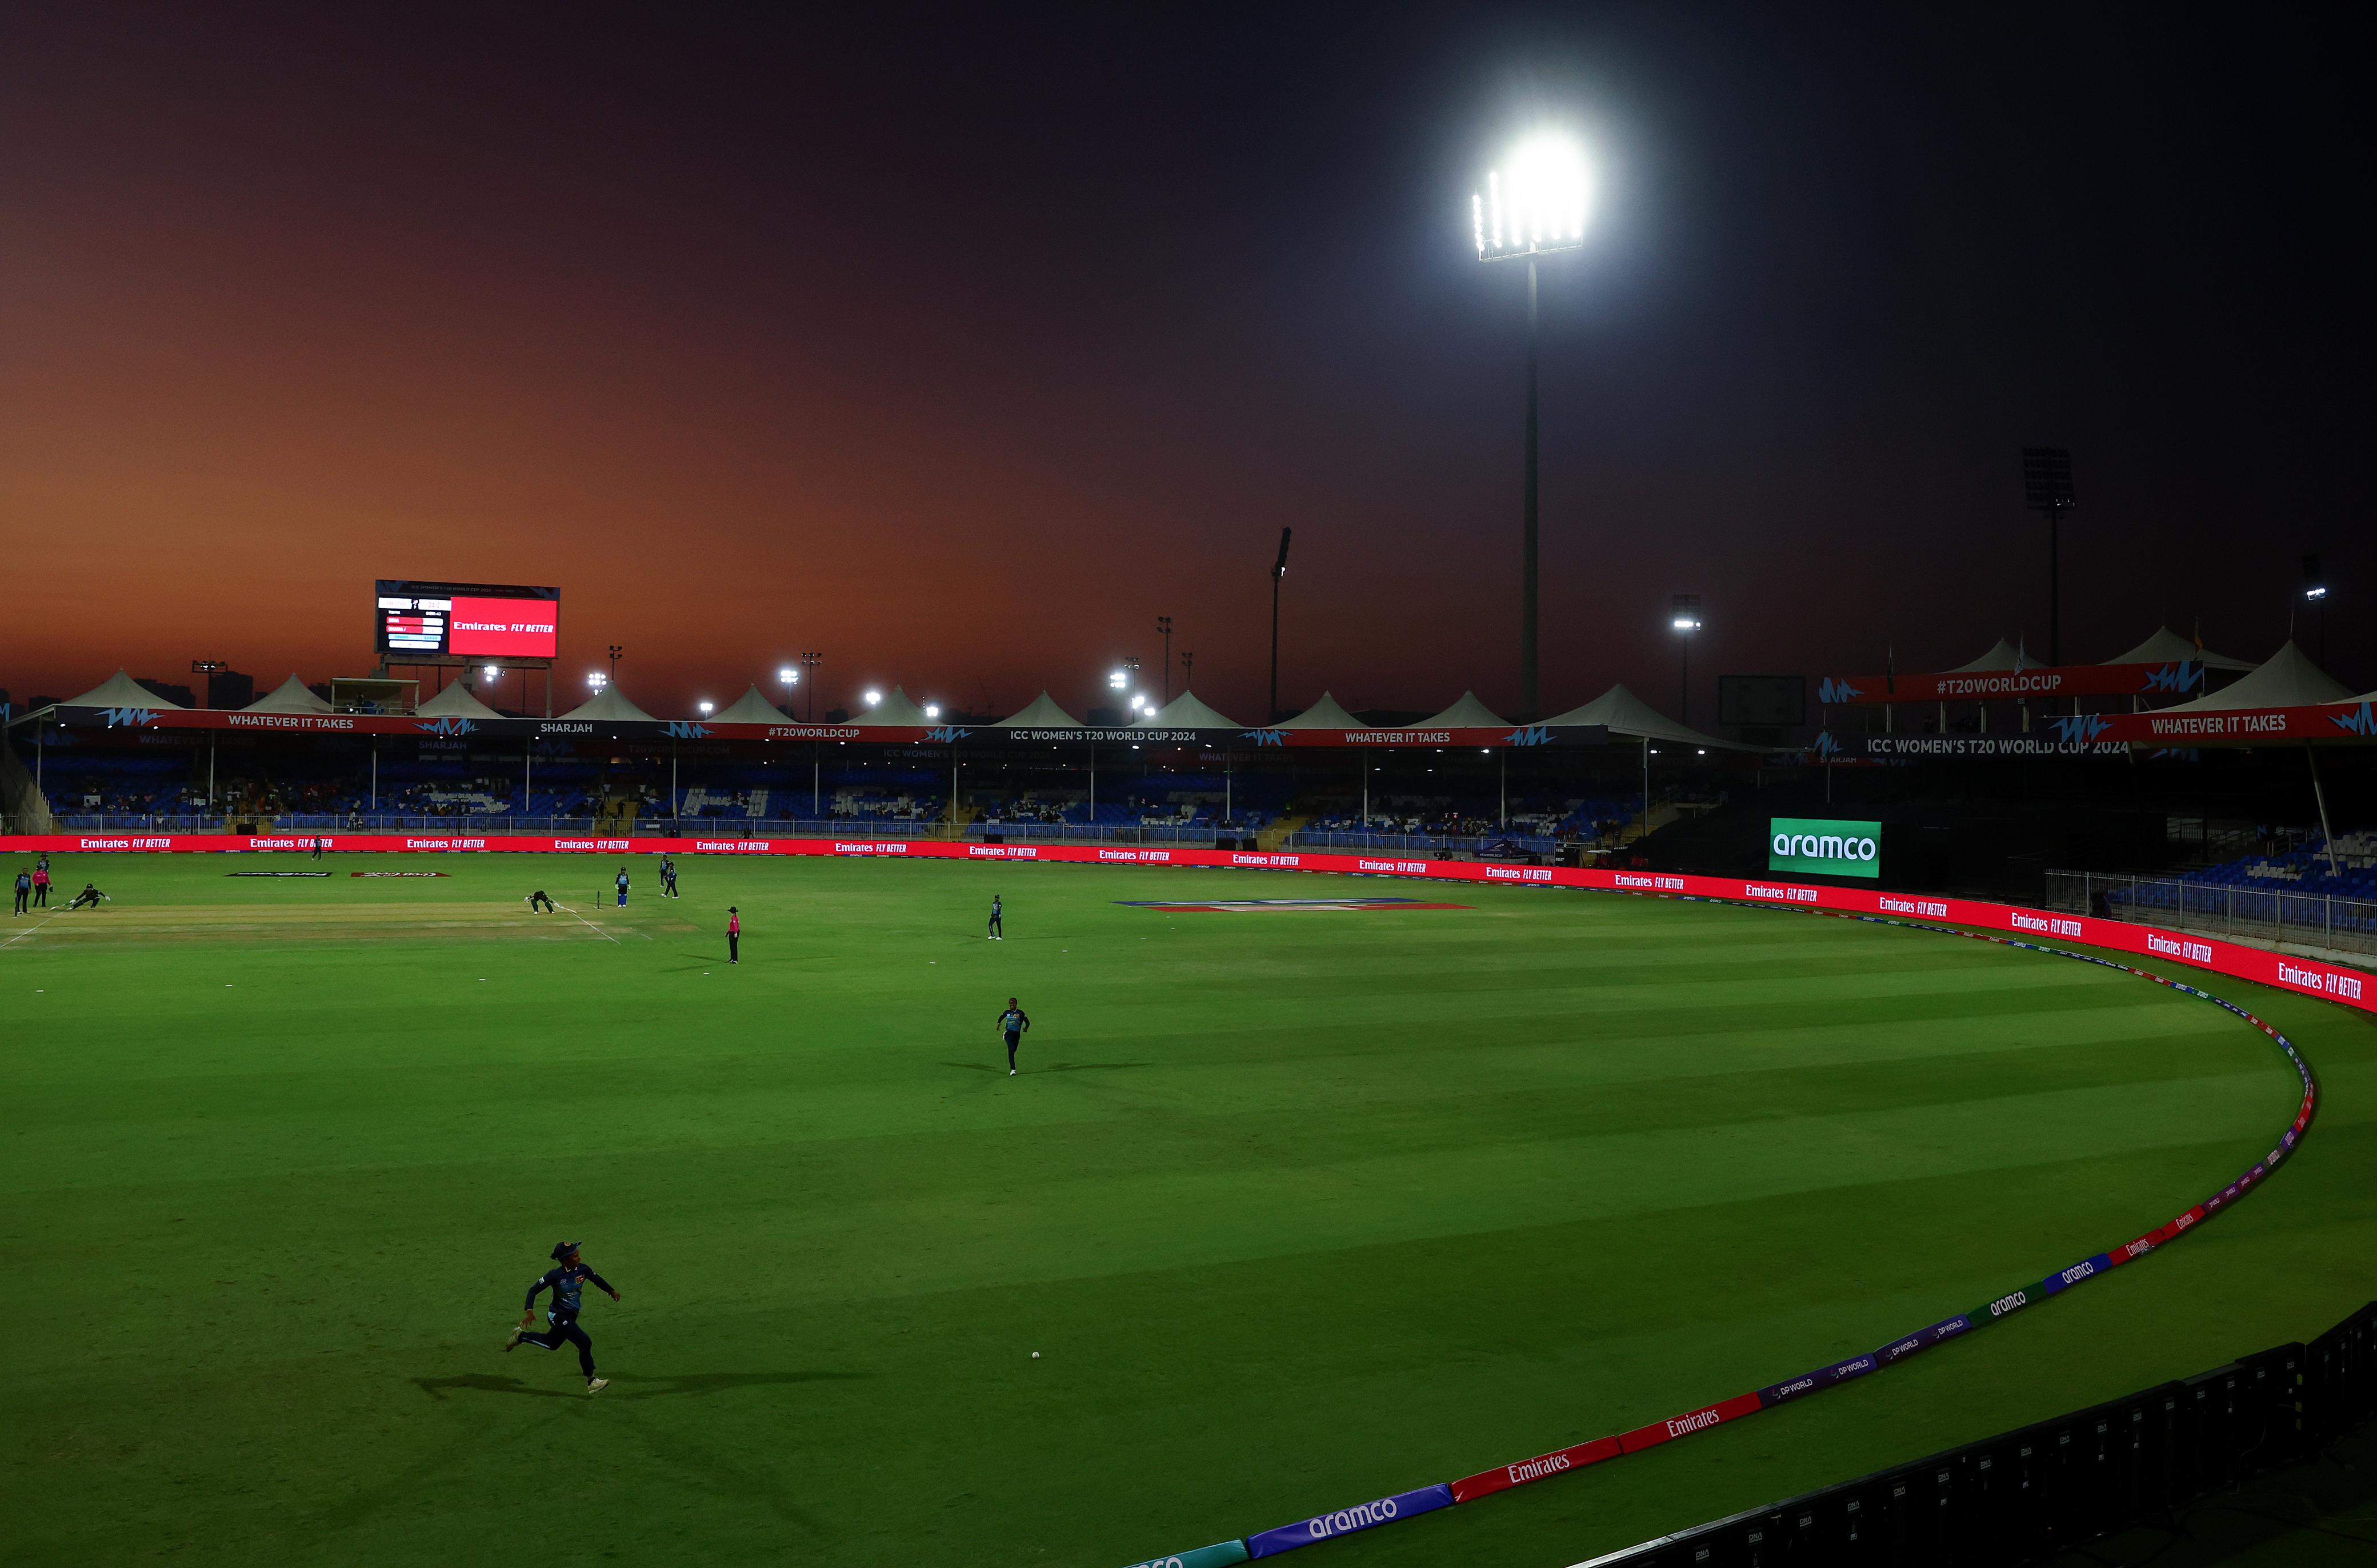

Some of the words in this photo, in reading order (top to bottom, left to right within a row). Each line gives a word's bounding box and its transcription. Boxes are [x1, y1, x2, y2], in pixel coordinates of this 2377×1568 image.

[453, 621, 507, 632] Emirates
[510, 623, 525, 632] FLY
[525, 624, 554, 633] BETTER
[1938, 676, 2061, 694] #T20WORLDCUP
[229, 715, 298, 726] WHATEVER
[302, 718, 313, 727] IT
[316, 719, 353, 728] TAKES
[541, 724, 592, 732] SHARJAH
[2152, 718, 2223, 733] WHATEVER
[2228, 717, 2239, 732] IT
[2243, 715, 2286, 731] TAKES
[769, 728, 859, 737] #T20WORLDCUP
[1011, 731, 1028, 739] ICC
[1031, 731, 1082, 739] WOMEN'S
[1085, 731, 1103, 739] T20
[1106, 731, 1145, 740] WORLD
[1148, 732, 1169, 740] CUP
[1171, 732, 1195, 741] 2024
[1346, 733, 1403, 742] WHATEVER
[1406, 733, 1415, 742] IT
[1418, 733, 1450, 742] TAKES
[419, 741, 467, 749] SHARJAH
[1868, 739, 1891, 752] ICC
[1895, 740, 1964, 753] WOMEN'S
[1969, 740, 1995, 753] T20
[1999, 740, 2054, 753] WORLD
[2058, 742, 2089, 754] CUP
[2092, 741, 2129, 754] 2024
[884, 749, 900, 757] ICC
[902, 749, 949, 758] WOMEN'S
[81, 839, 128, 847] Emirates
[133, 839, 145, 847] FLY
[146, 839, 170, 847] BETTER
[250, 838, 294, 847] Emirates
[298, 839, 308, 847] FLY
[407, 839, 448, 847] Emirates
[452, 839, 462, 847] FLY
[555, 840, 594, 849] Emirates
[597, 841, 607, 849] FLY
[697, 842, 734, 850] Emirates
[749, 842, 769, 850] BETTER
[836, 843, 873, 851] Emirates
[887, 844, 906, 852] BETTER
[1774, 834, 1876, 861] aramco
[970, 846, 1005, 855] Emirates
[1007, 847, 1017, 855] FLY
[1018, 848, 1036, 856] BETTER
[1099, 850, 1136, 859] Emirates
[1139, 851, 1149, 859] FLY
[1150, 852, 1169, 860] BETTER
[1233, 854, 1267, 864] Emirates
[1270, 856, 1279, 865] FLY
[1280, 857, 1299, 865] BETTER
[1360, 860, 1394, 870] Emirates
[1397, 862, 1406, 871] FLY
[1407, 863, 1426, 873] BETTER
[1486, 867, 1520, 878] Emirates
[1523, 870, 1532, 879] FLY
[1533, 870, 1551, 880] BETTER
[1615, 875, 1652, 886] Emirates
[1655, 877, 1664, 887] FLY
[1665, 878, 1683, 889] BETTER
[1746, 885, 1783, 898] Emirates
[1787, 888, 1796, 899] FLY
[1798, 889, 1817, 902] BETTER
[1880, 897, 1914, 913] Emirates
[1918, 902, 1927, 914] FLY
[1927, 903, 1947, 917] BETTER
[2012, 913, 2047, 931] Emirates
[2051, 917, 2060, 933] FLY
[2062, 919, 2082, 937] BETTER
[2148, 934, 2180, 955] Emirates
[2183, 942, 2193, 959] FLY
[2193, 944, 2211, 963] BETTER
[2279, 962, 2322, 989] Emirates
[2326, 973, 2338, 993] FLY
[2339, 976, 2361, 999] BETTER
[2175, 1213, 2194, 1230] Emirates
[2126, 1238, 2150, 1257] Emirates
[2062, 1261, 2094, 1285] aramco
[1990, 1291, 2027, 1317] aramco
[1938, 1327, 1946, 1335] DP
[1946, 1320, 1963, 1332] WORLD
[1892, 1348, 1900, 1356] DP
[1899, 1339, 1918, 1353] WORLD
[1838, 1367, 1847, 1375] DP
[1847, 1359, 1868, 1372] WORLD
[1780, 1386, 1790, 1395] DP
[1790, 1378, 1813, 1393] WORLD
[1666, 1407, 1719, 1438] Emirates
[1507, 1453, 1570, 1484] Emirates
[1980, 1459, 1991, 1467] DNA
[1938, 1471, 1949, 1480] DNA
[1894, 1486, 1905, 1495] DNA
[1847, 1501, 1859, 1510] DNA
[1308, 1499, 1398, 1538] aramco
[1799, 1515, 1812, 1525] DNA
[1749, 1531, 1762, 1541] DNA
[1696, 1549, 1710, 1558] DNA
